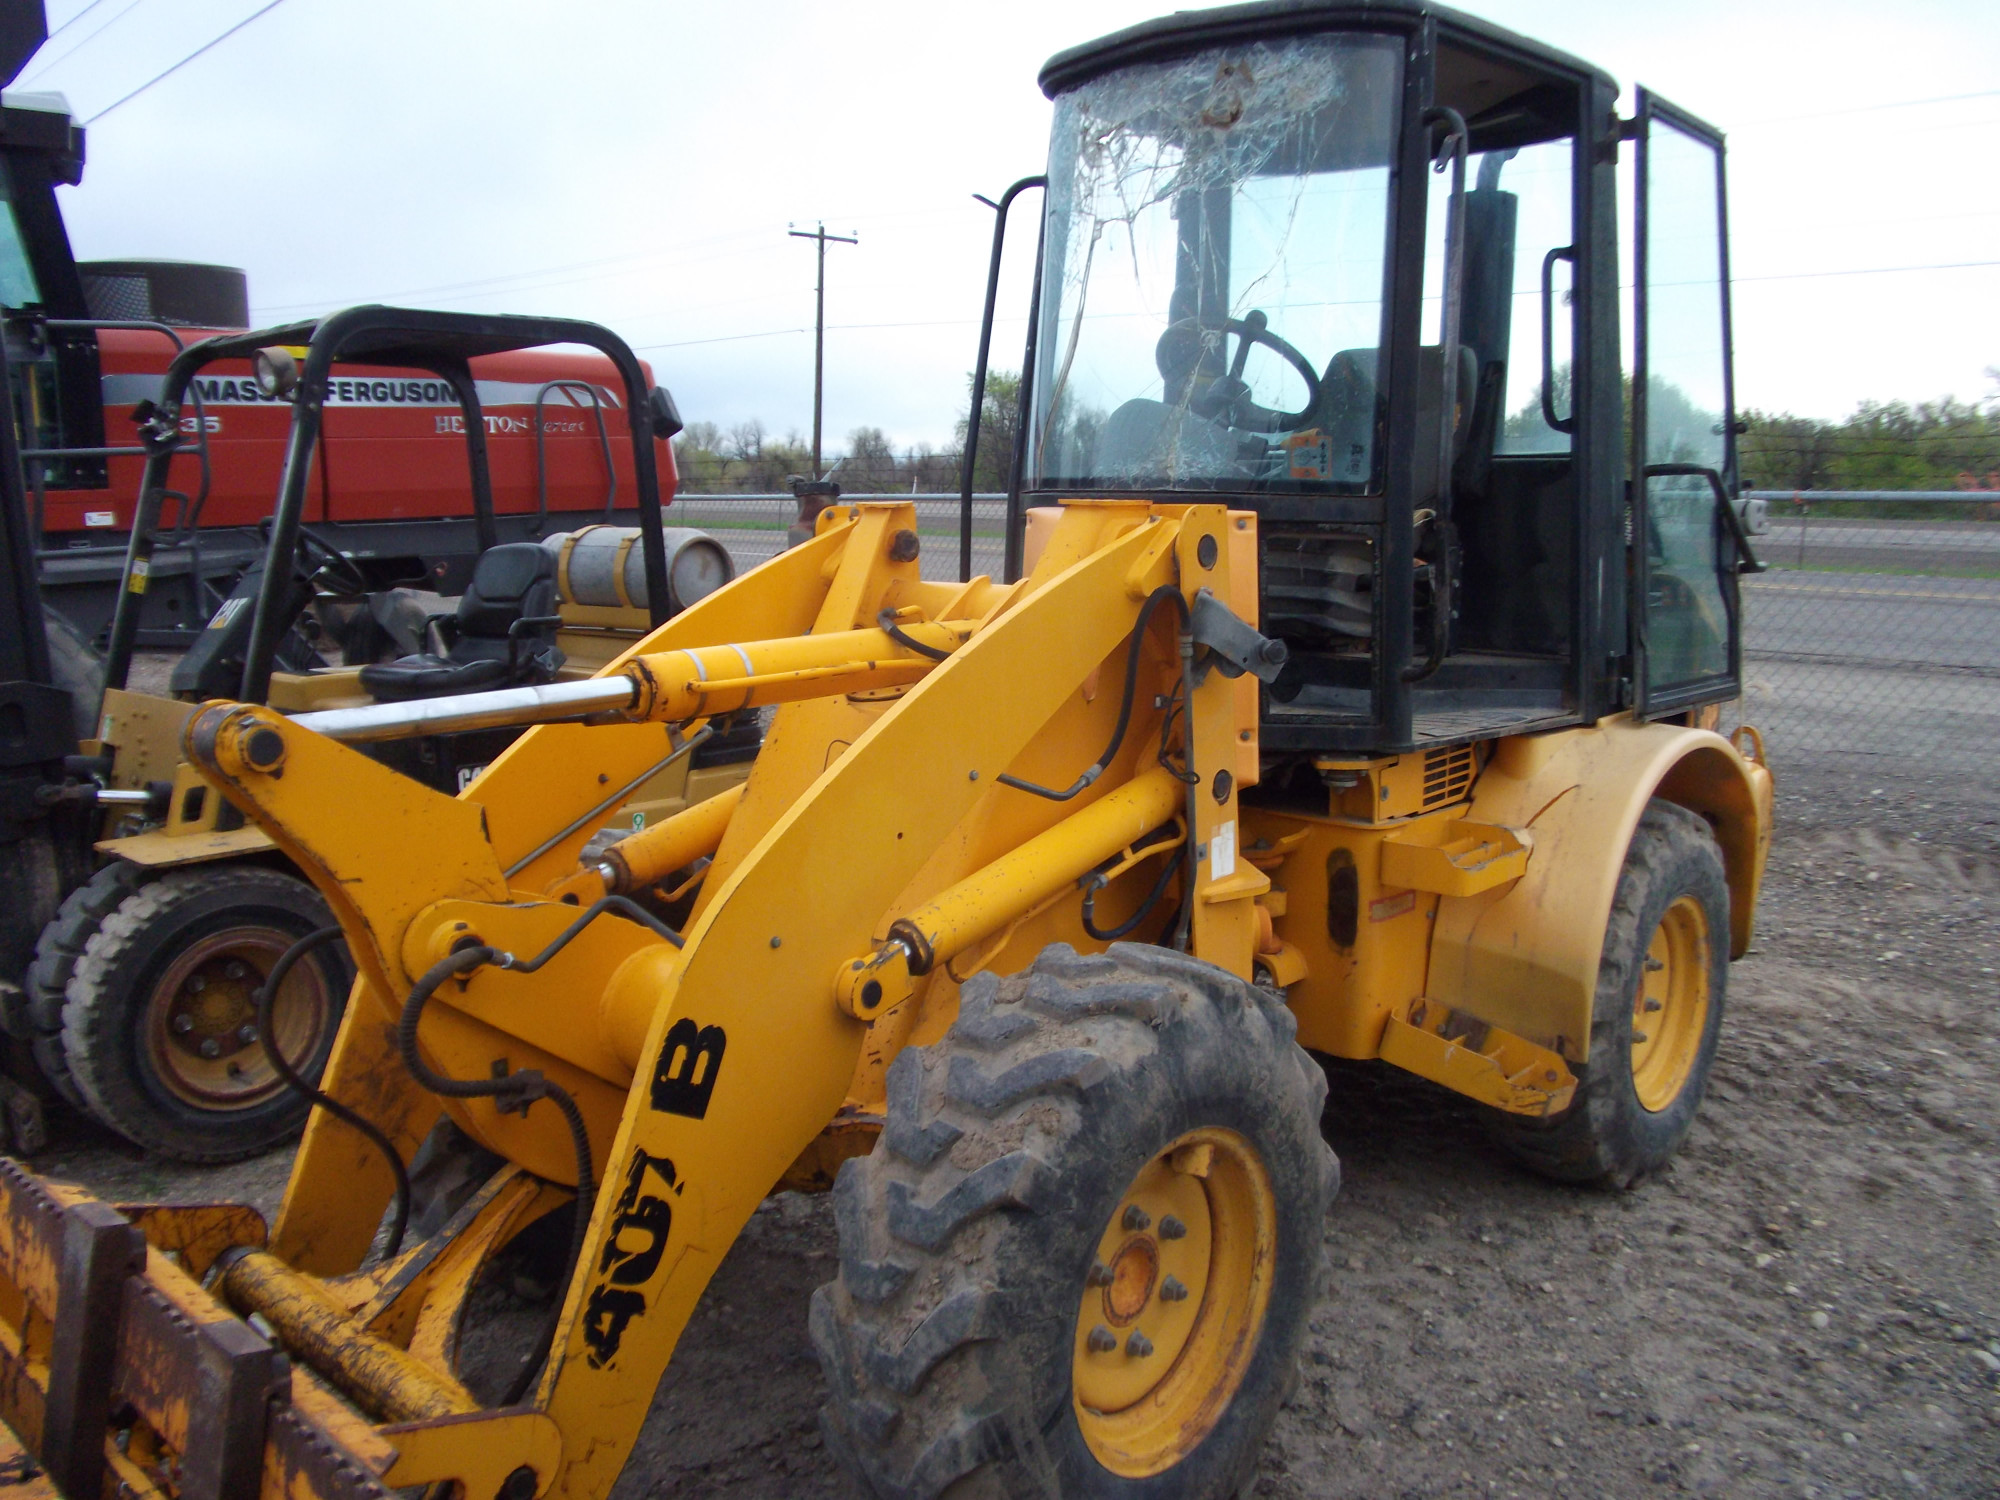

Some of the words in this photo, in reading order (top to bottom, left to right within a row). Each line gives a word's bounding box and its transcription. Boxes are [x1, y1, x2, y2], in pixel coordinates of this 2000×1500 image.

[434, 415, 529, 434] HETON
[582, 1145, 685, 1371] 407
[650, 1017, 727, 1120] B
